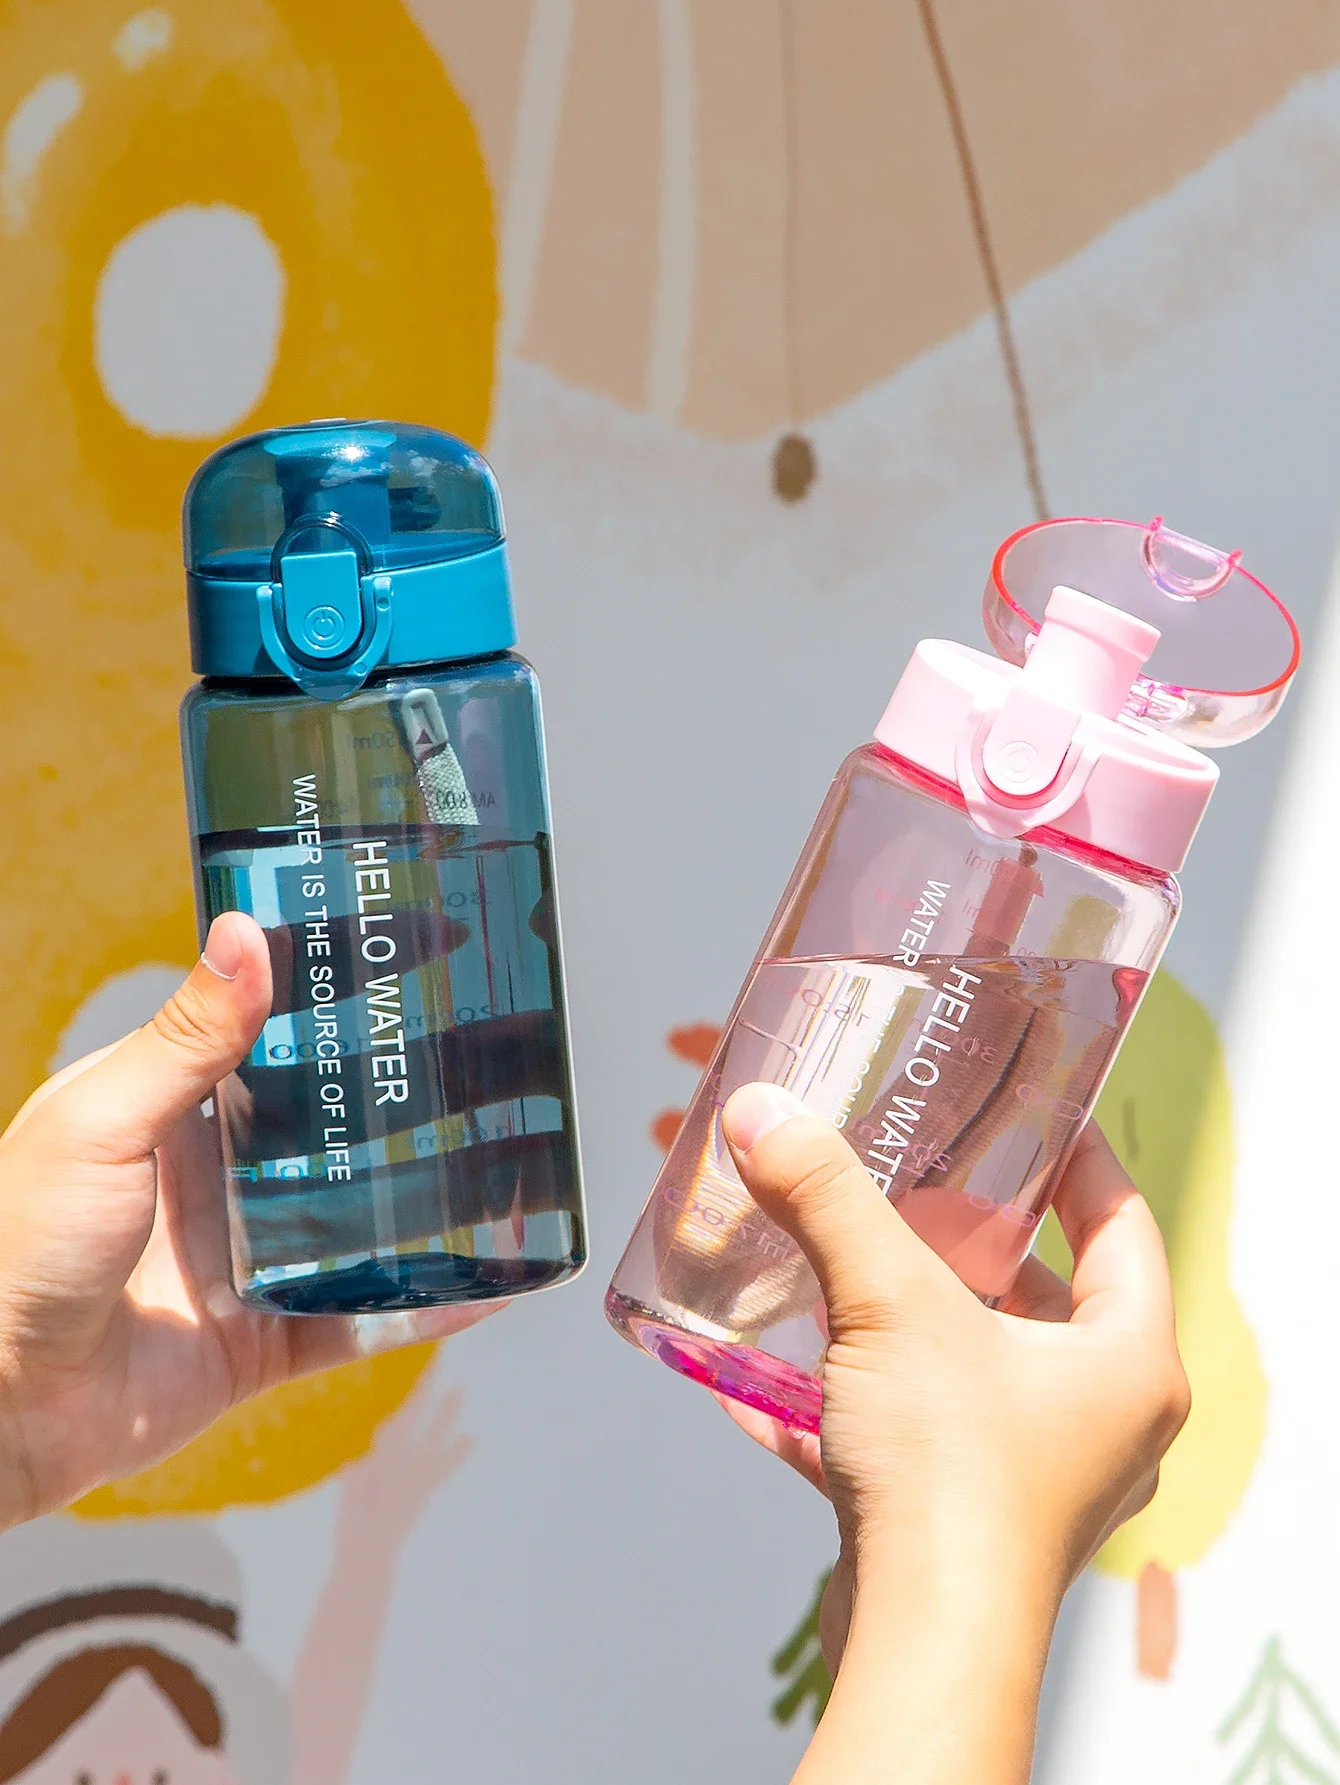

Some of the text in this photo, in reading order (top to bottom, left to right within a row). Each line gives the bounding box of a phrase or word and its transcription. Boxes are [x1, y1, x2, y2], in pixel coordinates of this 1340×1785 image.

[352, 840, 398, 964] HELLO
[892, 879, 952, 968] WATER
[292, 774, 352, 1182] WATER IS THE SOURCE OF LIFE
[364, 972, 410, 1107] WATER
[903, 965, 983, 1088] HELLO
[865, 1094, 927, 1198] WATE
